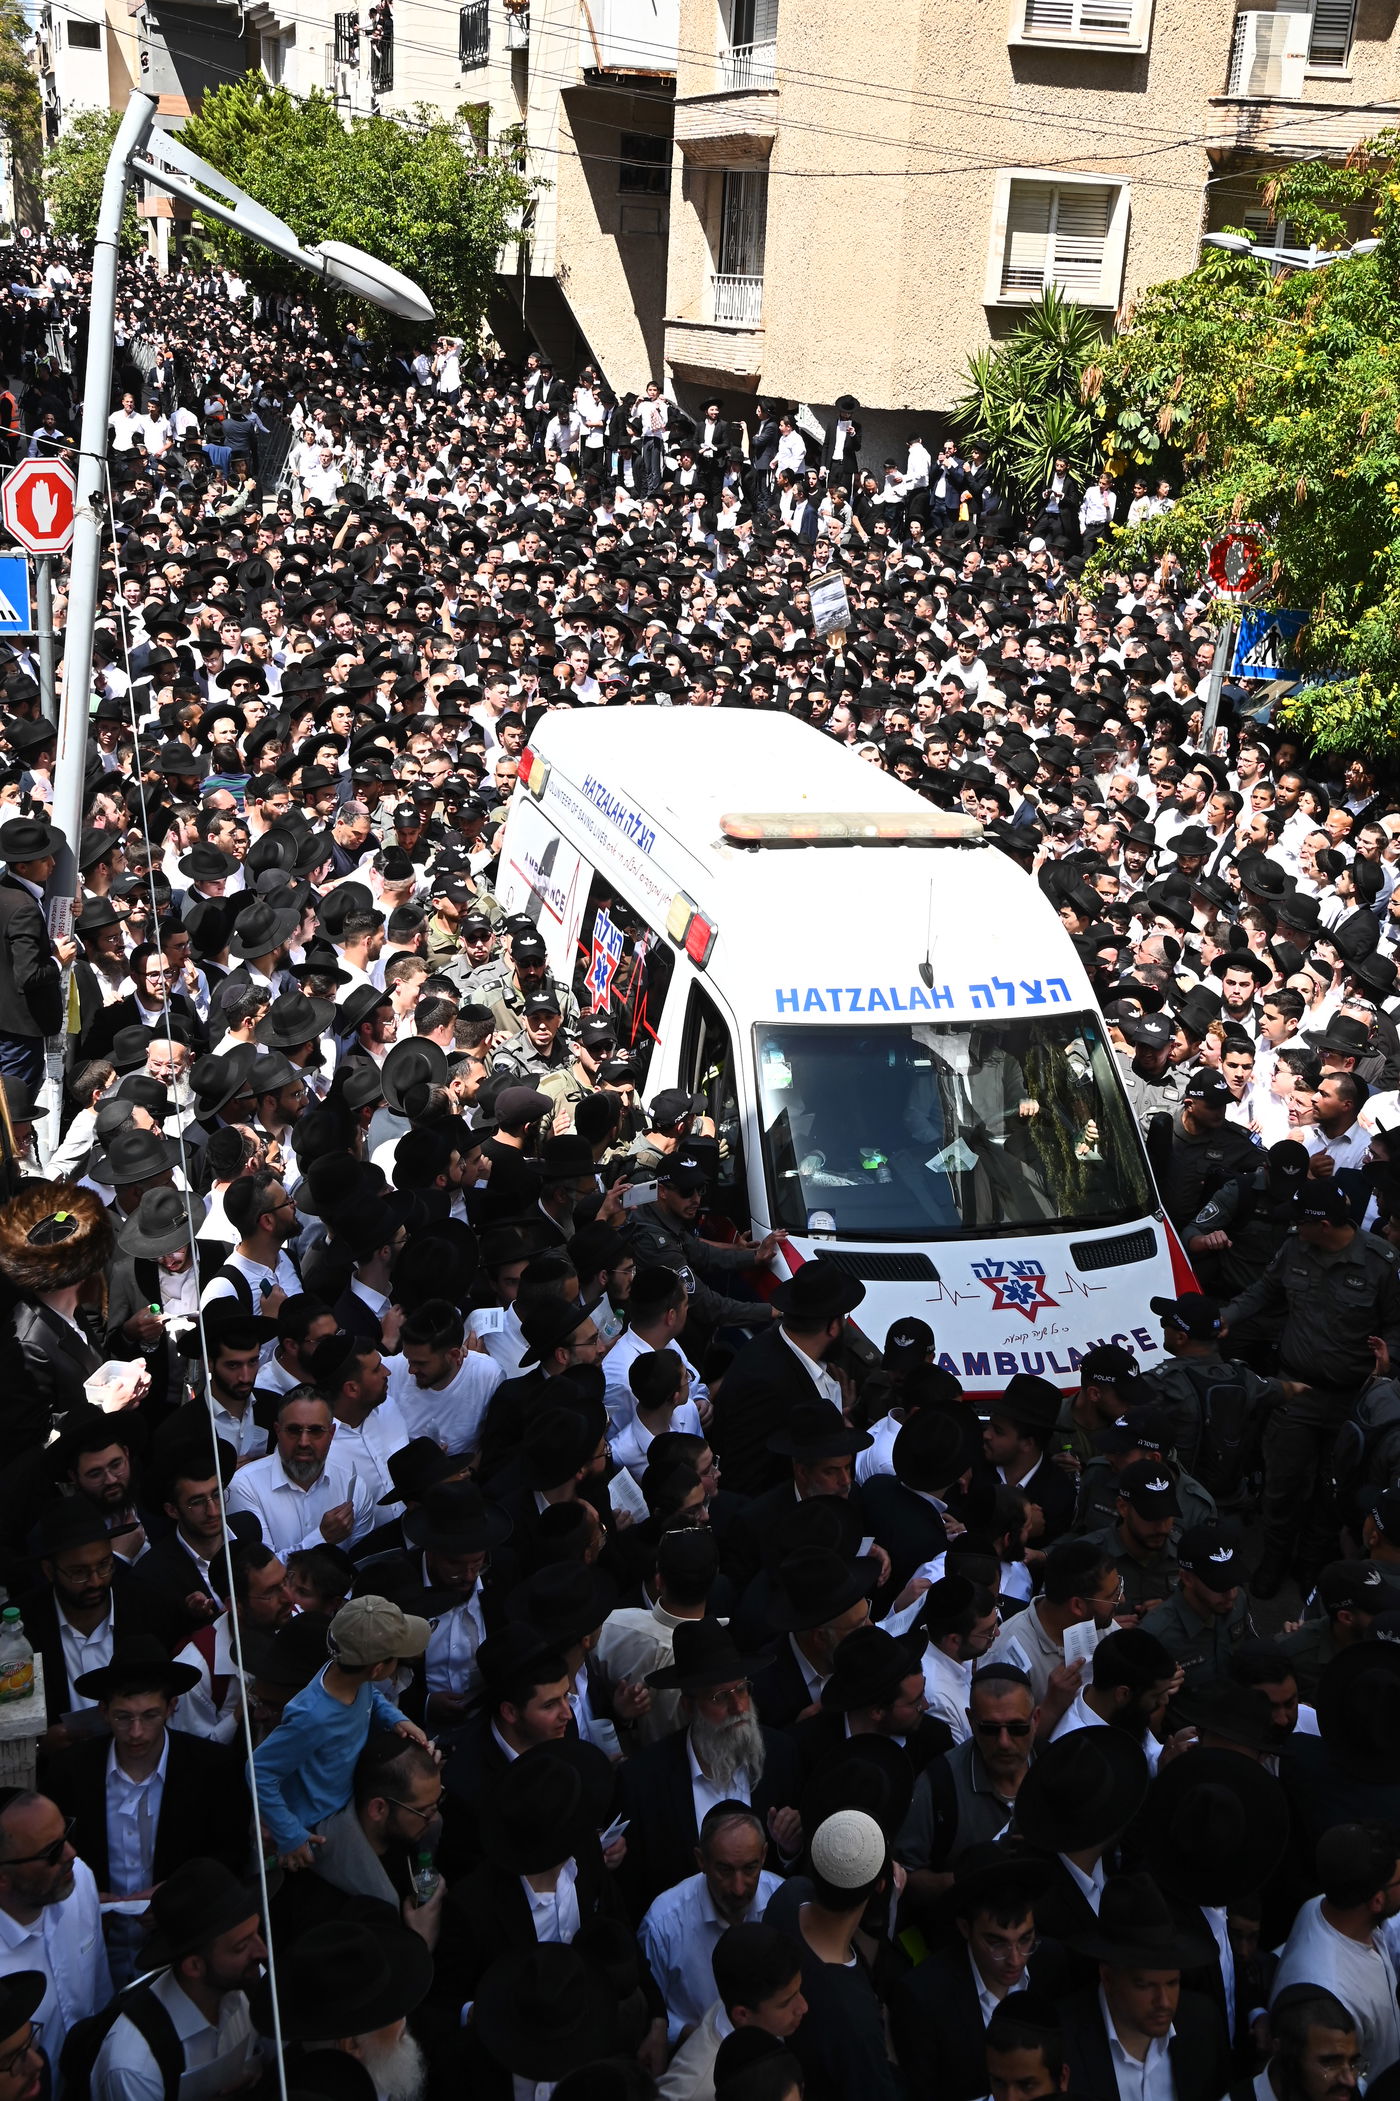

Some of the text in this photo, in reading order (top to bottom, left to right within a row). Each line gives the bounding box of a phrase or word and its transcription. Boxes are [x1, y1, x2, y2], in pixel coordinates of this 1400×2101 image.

[582, 774, 627, 827] HATZALAH
[571, 801, 579, 814] OF
[577, 808, 595, 832] SAVING
[593, 823, 608, 846] LIVES
[624, 813, 656, 854] הצלה
[594, 911, 623, 961] הצלה
[775, 985, 954, 1012] HATZALAH
[969, 976, 1072, 1009] הצלה
[1304, 1208, 1326, 1216] משטרה
[970, 1258, 1045, 1279] הצלה
[1003, 1333, 1029, 1345] קובעת
[1031, 1326, 1048, 1341] שניה
[1051, 1322, 1060, 1335] כל
[1093, 1373, 1117, 1383] POLICE
[1137, 1438, 1160, 1449] משטרה
